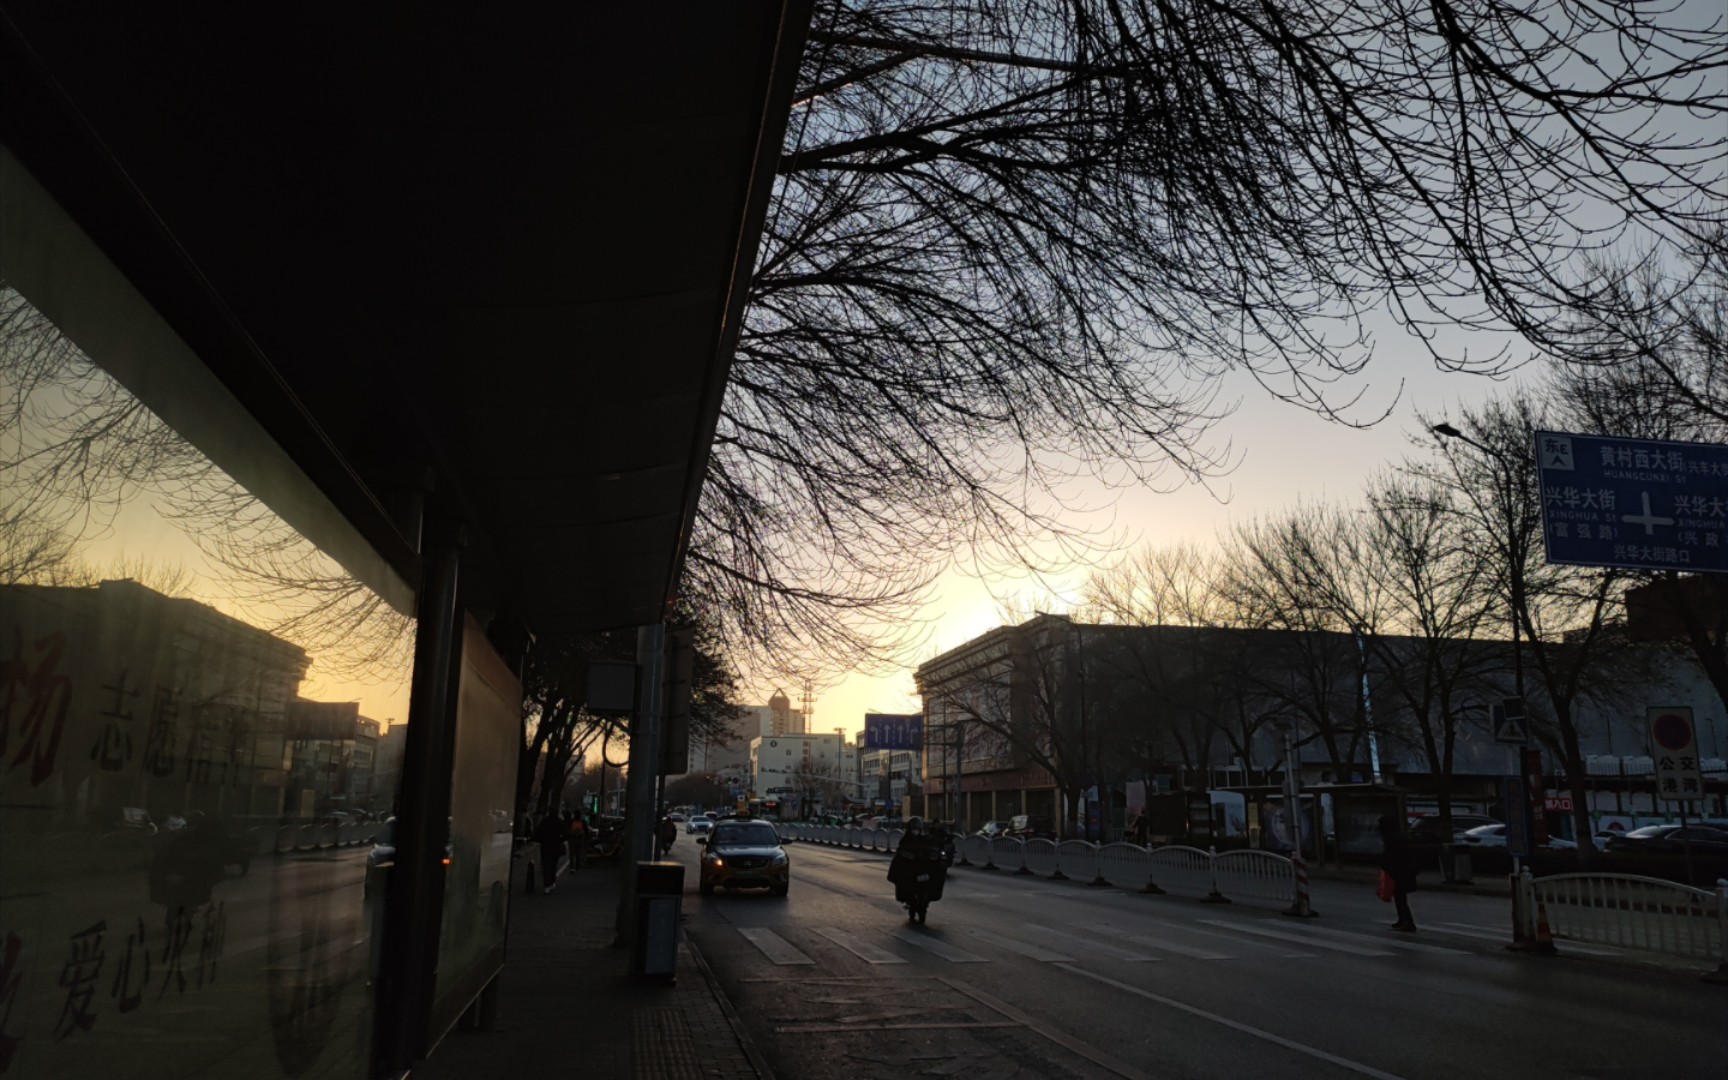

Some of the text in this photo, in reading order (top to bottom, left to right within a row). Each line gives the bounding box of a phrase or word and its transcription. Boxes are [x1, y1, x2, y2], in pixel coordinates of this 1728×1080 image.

[1600, 445, 1684, 472] 黄村西大街
[1545, 486, 1616, 511] 兴华大街
[1673, 494, 1728, 519] 兴华大
[1549, 510, 1600, 521] XINGHUA
[1613, 544, 1691, 564] 兴华大街路口
[1659, 756, 1695, 770] 公交
